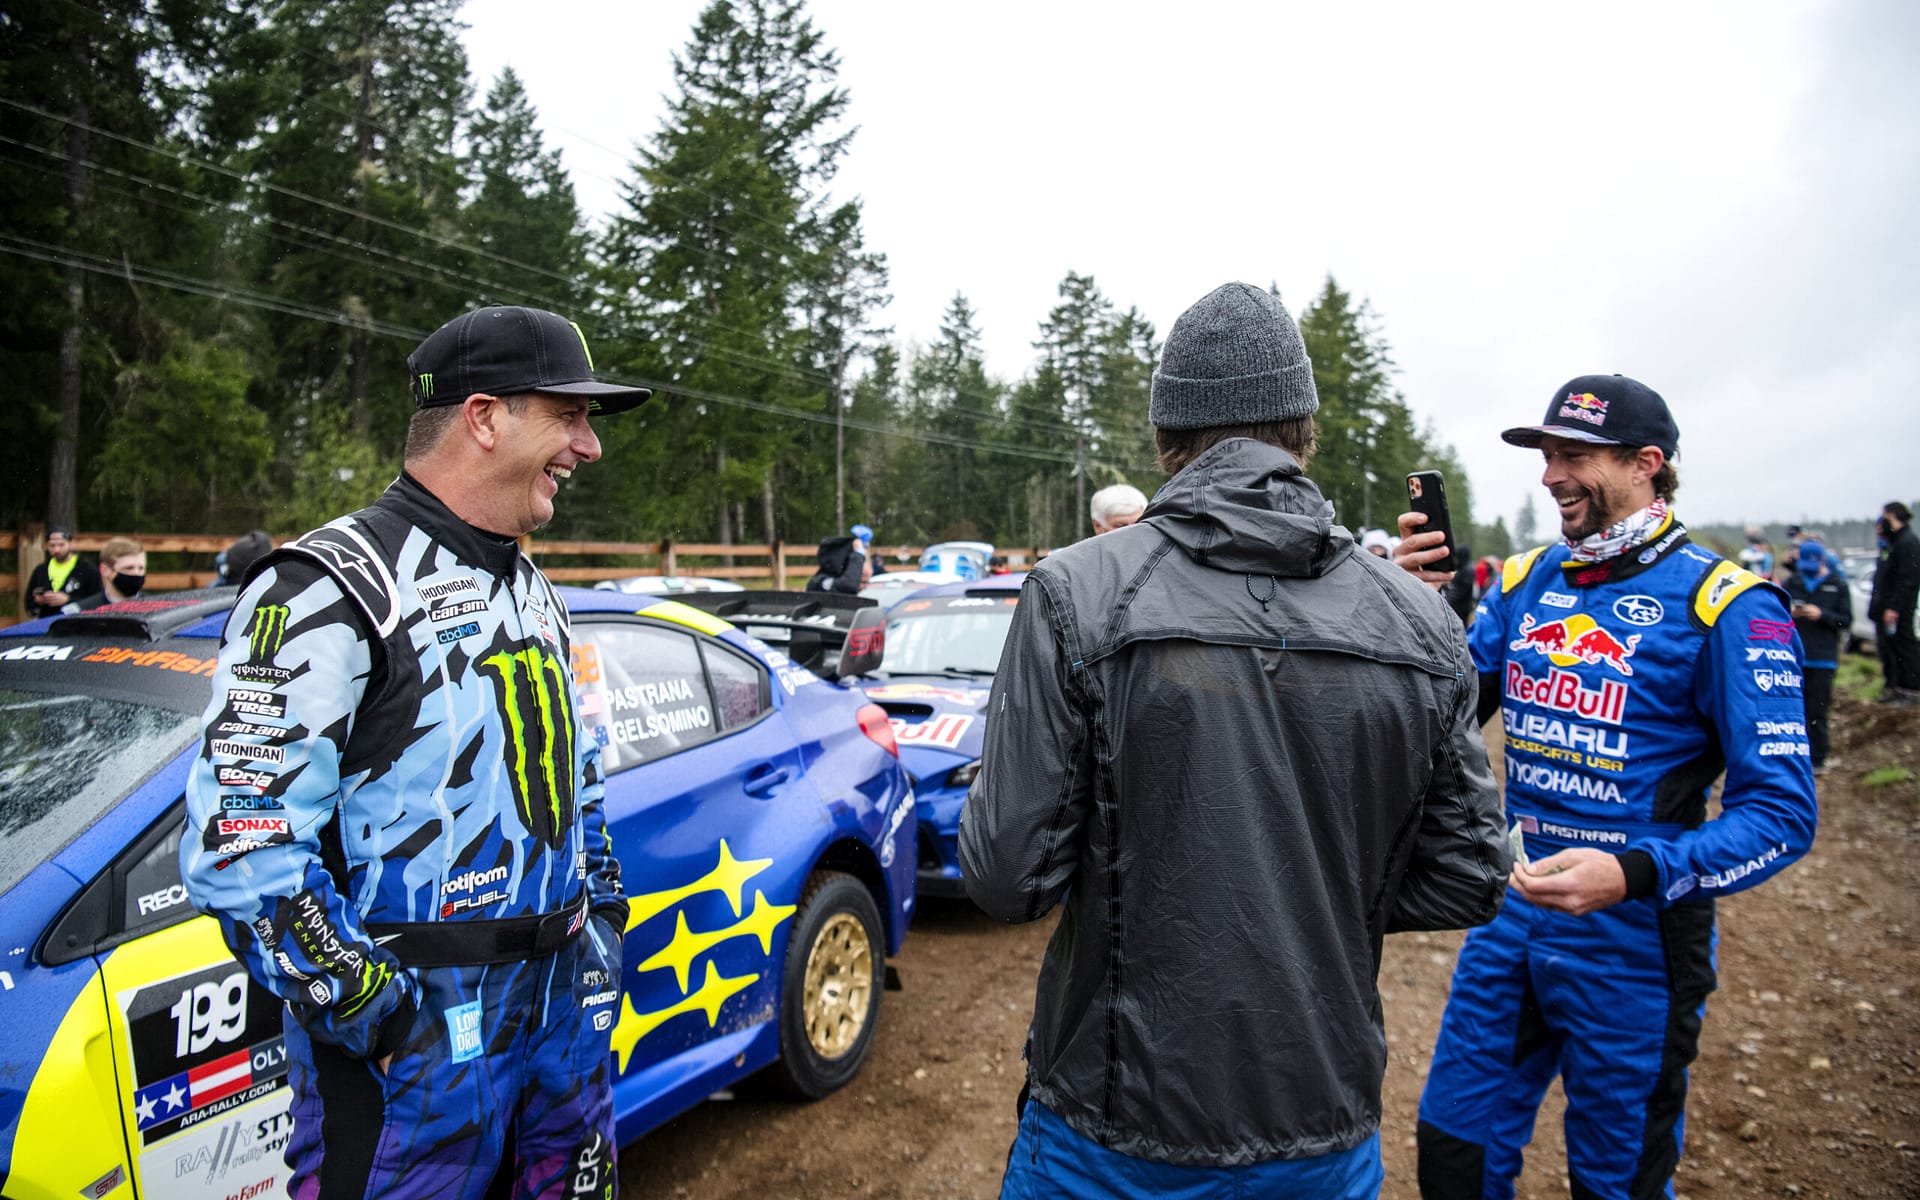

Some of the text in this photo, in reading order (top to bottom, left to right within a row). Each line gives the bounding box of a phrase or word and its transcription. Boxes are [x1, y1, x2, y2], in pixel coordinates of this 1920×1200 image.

[432, 600, 485, 620] can-am
[439, 623, 479, 643] cbdMD
[229, 690, 272, 704] TOYO
[604, 678, 694, 712] PASTRANA
[233, 702, 282, 717] TIRES
[218, 722, 287, 738] can-am
[613, 705, 710, 744] GELSOMINO
[1586, 756, 1624, 772] USA
[222, 796, 283, 810] cbdMD
[221, 819, 284, 832] SONAX
[441, 866, 508, 896] rotiform
[582, 990, 617, 1009] RIGID
[170, 972, 249, 1059] 199
[180, 1081, 277, 1128] ARA-RALLY.COM
